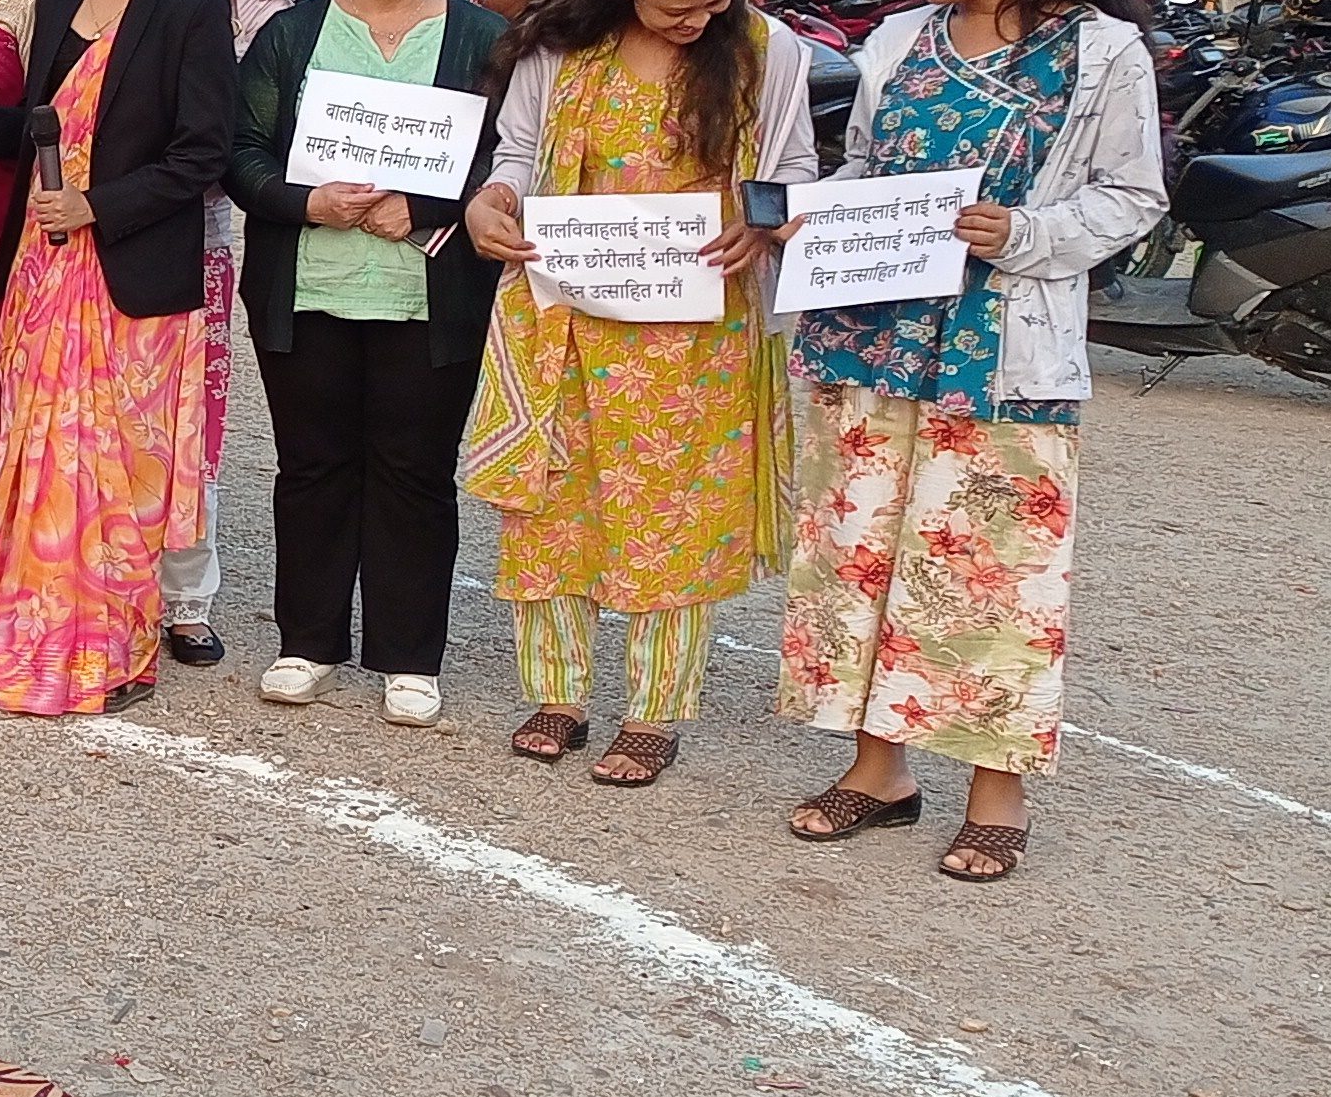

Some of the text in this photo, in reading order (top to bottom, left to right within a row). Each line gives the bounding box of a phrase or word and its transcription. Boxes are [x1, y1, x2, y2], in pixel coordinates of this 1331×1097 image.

[342, 135, 377, 166] नेपाल
[379, 145, 421, 171] निर्माण
[643, 215, 671, 240] नाई
[545, 248, 579, 274] हरेक
[584, 247, 646, 271] छोरीलाई
[559, 280, 584, 301] दिन
[590, 278, 651, 302] उत्साहित
